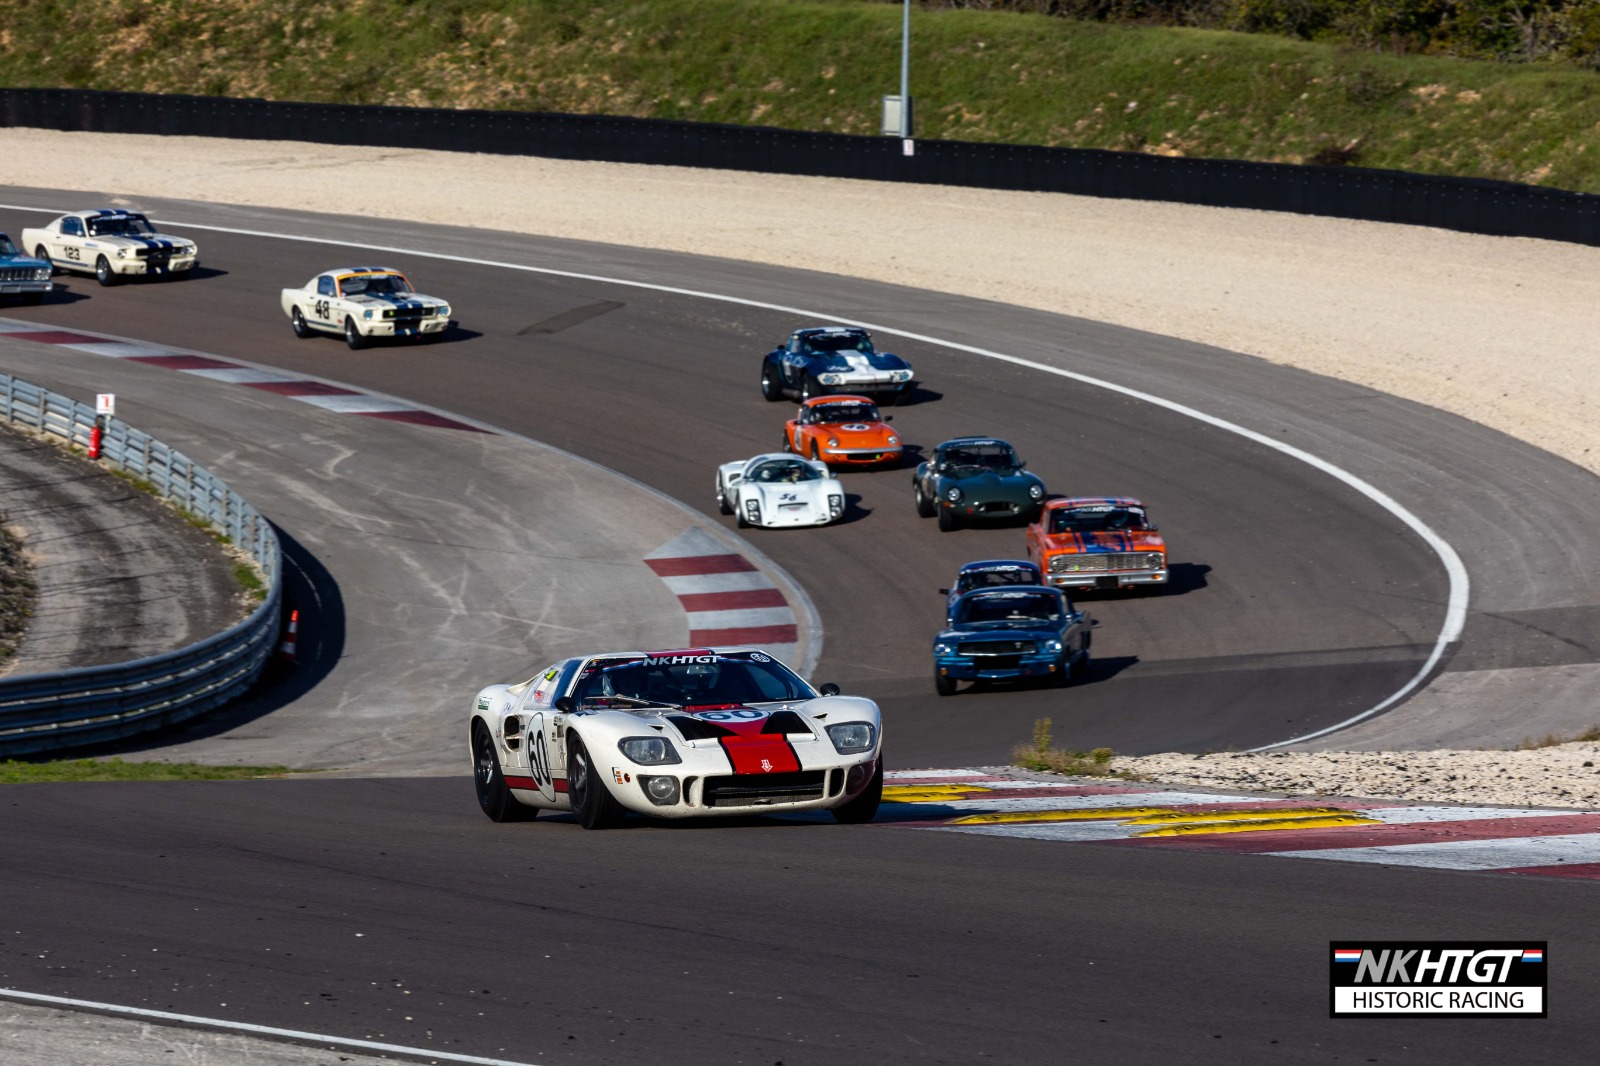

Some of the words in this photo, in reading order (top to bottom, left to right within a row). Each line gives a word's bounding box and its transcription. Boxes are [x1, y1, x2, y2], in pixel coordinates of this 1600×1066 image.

[64, 245, 81, 261] 123
[315, 300, 330, 320] 48
[780, 493, 798, 502] 56
[643, 655, 724, 667] NKHTGT
[699, 710, 763, 721] 60
[527, 729, 551, 787] 60
